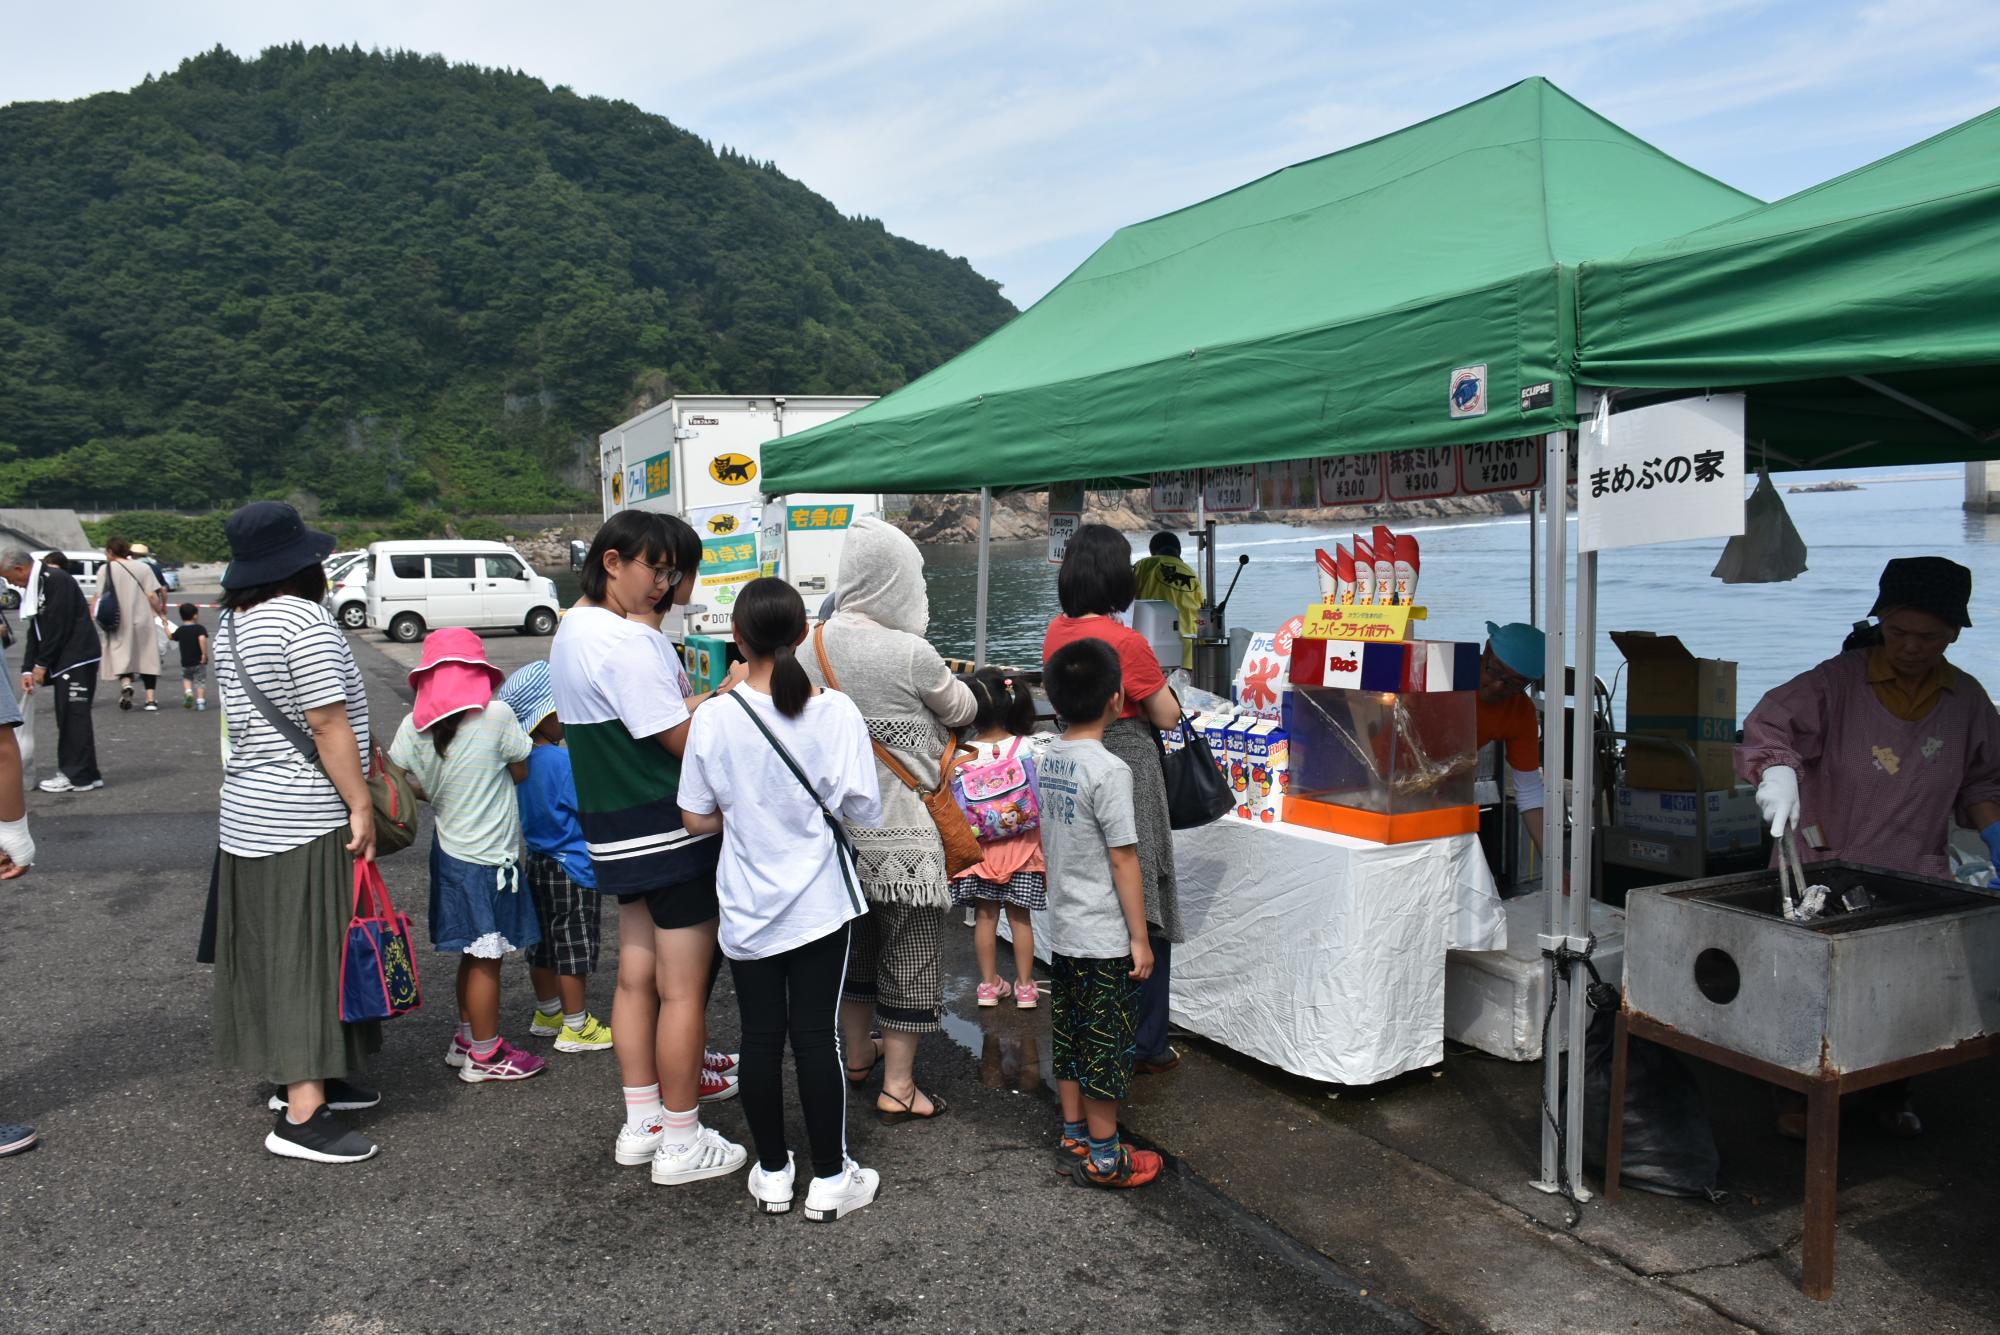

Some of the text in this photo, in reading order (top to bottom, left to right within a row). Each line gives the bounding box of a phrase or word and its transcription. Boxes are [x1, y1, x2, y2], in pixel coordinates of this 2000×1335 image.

[1521, 383, 1550, 398] ECLIPSE
[1481, 461, 1518, 482] ¥200
[1590, 449, 1725, 498] まめぶの家
[1336, 479, 1365, 496] ¥300
[1405, 472, 1439, 490] ¥300
[792, 508, 848, 527] 宅急便
[712, 613, 734, 623] D07
[1308, 622, 1395, 638] スーパーフライポテト
[1242, 657, 1281, 710] 氷
[766, 1202, 790, 1212] PUMA
